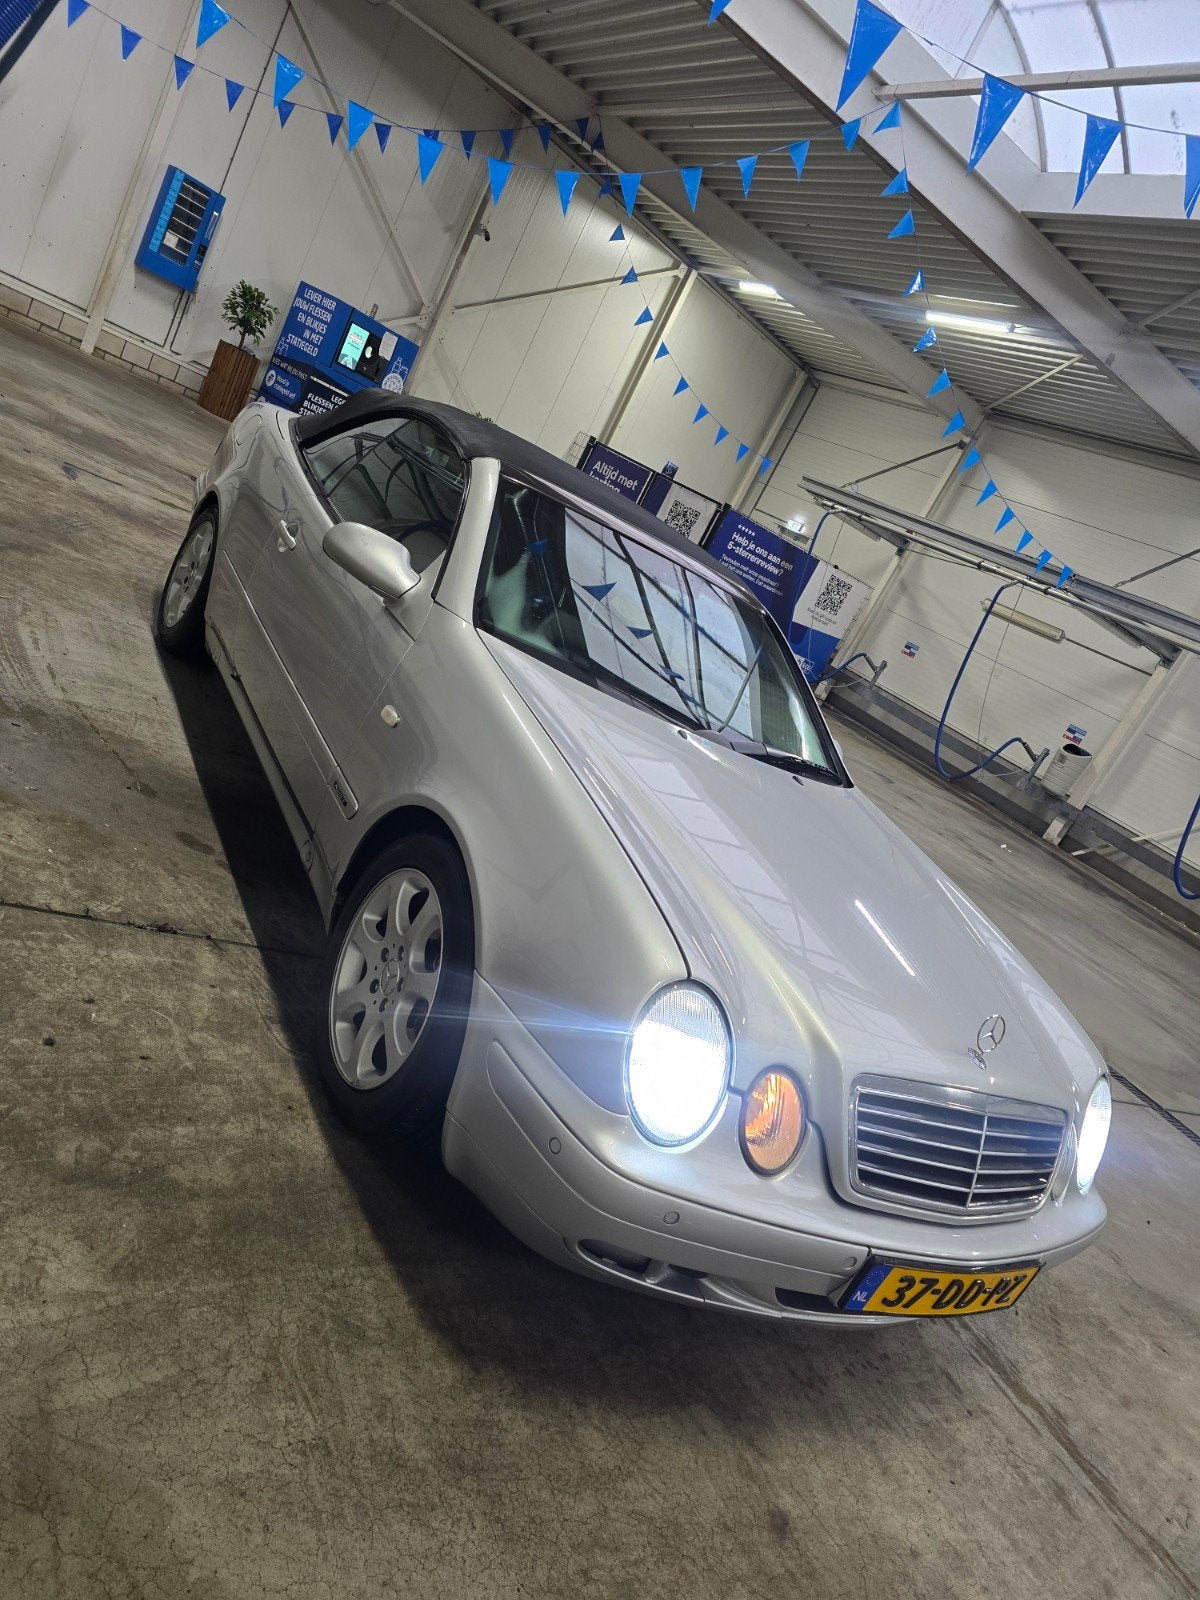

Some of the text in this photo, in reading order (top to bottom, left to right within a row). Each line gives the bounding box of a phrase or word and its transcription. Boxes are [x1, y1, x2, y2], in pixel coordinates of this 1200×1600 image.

[293, 296, 332, 323] JOUW FLESSEN
[304, 288, 337, 311] LEVER HIER
[297, 312, 327, 334] EN BLIKJES
[286, 333, 319, 357] STATIEGELD
[303, 329, 323, 345] IN MET
[307, 392, 334, 410] FLESSEN
[592, 460, 638, 491] Altijd met
[727, 541, 784, 577] 5-sterrenreview?
[731, 531, 794, 572] Help je ons aan een
[852, 1275, 1028, 1310] NL 37-DD-PZ
